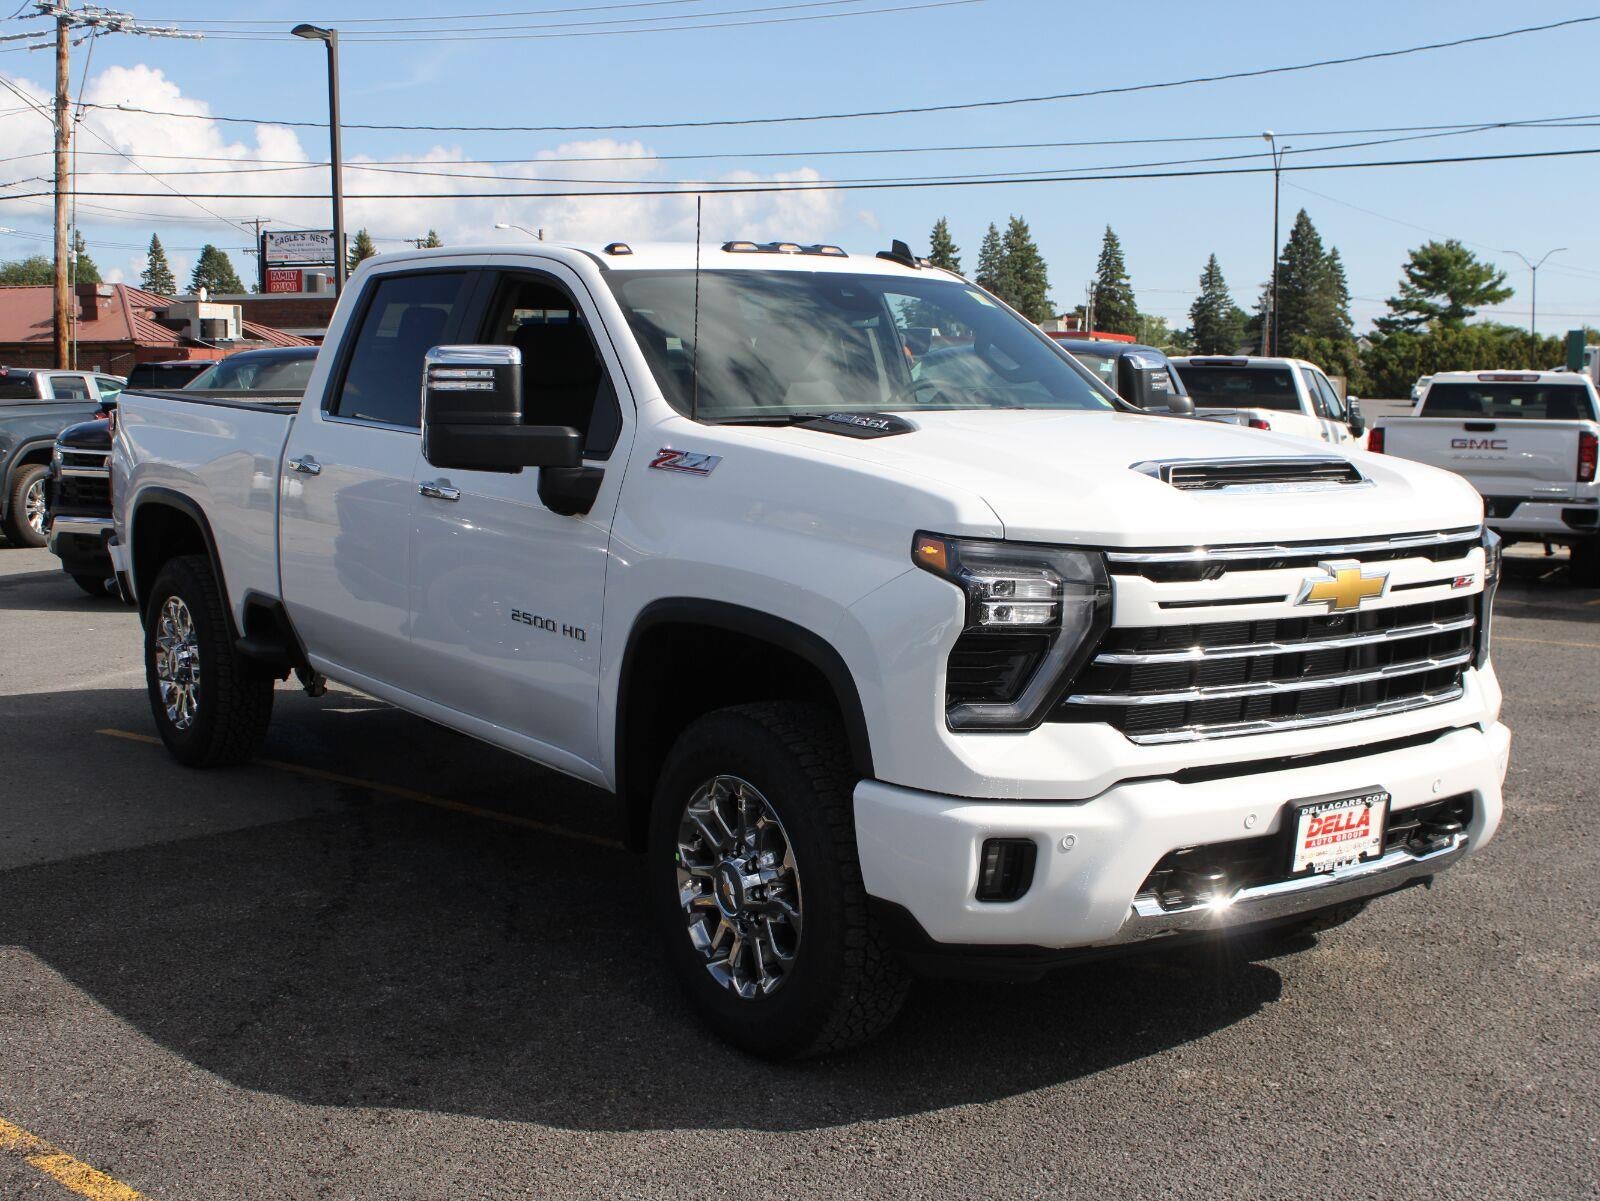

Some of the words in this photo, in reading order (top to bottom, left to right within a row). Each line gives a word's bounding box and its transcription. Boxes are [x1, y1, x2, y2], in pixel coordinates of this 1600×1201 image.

[275, 234, 306, 247] EAGLE'S
[310, 234, 328, 245] NEST
[271, 271, 298, 281] FAMILY
[1451, 438, 1508, 450] GMC
[648, 447, 724, 477] Z71
[511, 608, 557, 633] 2500
[562, 623, 587, 642] HD
[1301, 793, 1389, 816] DELLACARS.COM
[1306, 808, 1370, 838] DELLA
[1311, 837, 1333, 848] AUTO
[1336, 830, 1364, 843] GROUP
